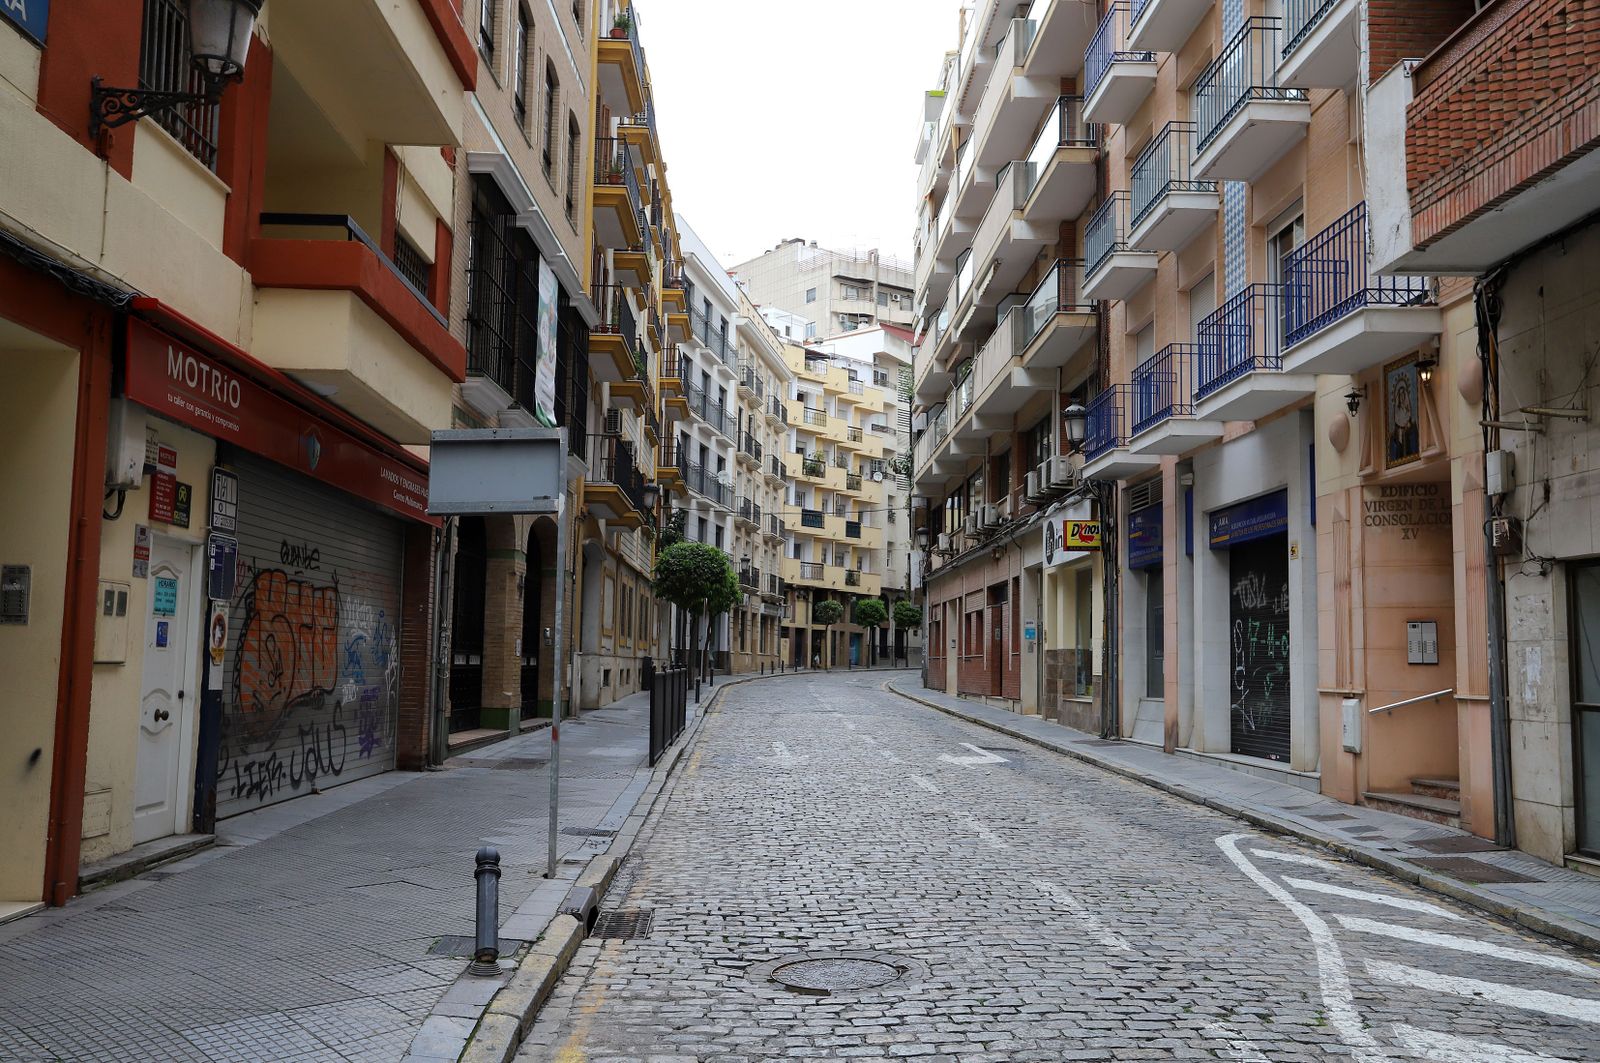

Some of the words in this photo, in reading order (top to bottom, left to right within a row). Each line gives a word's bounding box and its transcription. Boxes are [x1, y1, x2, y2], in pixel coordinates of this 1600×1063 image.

[1380, 485, 1438, 498] EDIFICIO
[1364, 499, 1412, 513] VIRGEN
[1418, 498, 1437, 511] DE
[1440, 497, 1452, 510] L
[1401, 527, 1420, 540] XV
